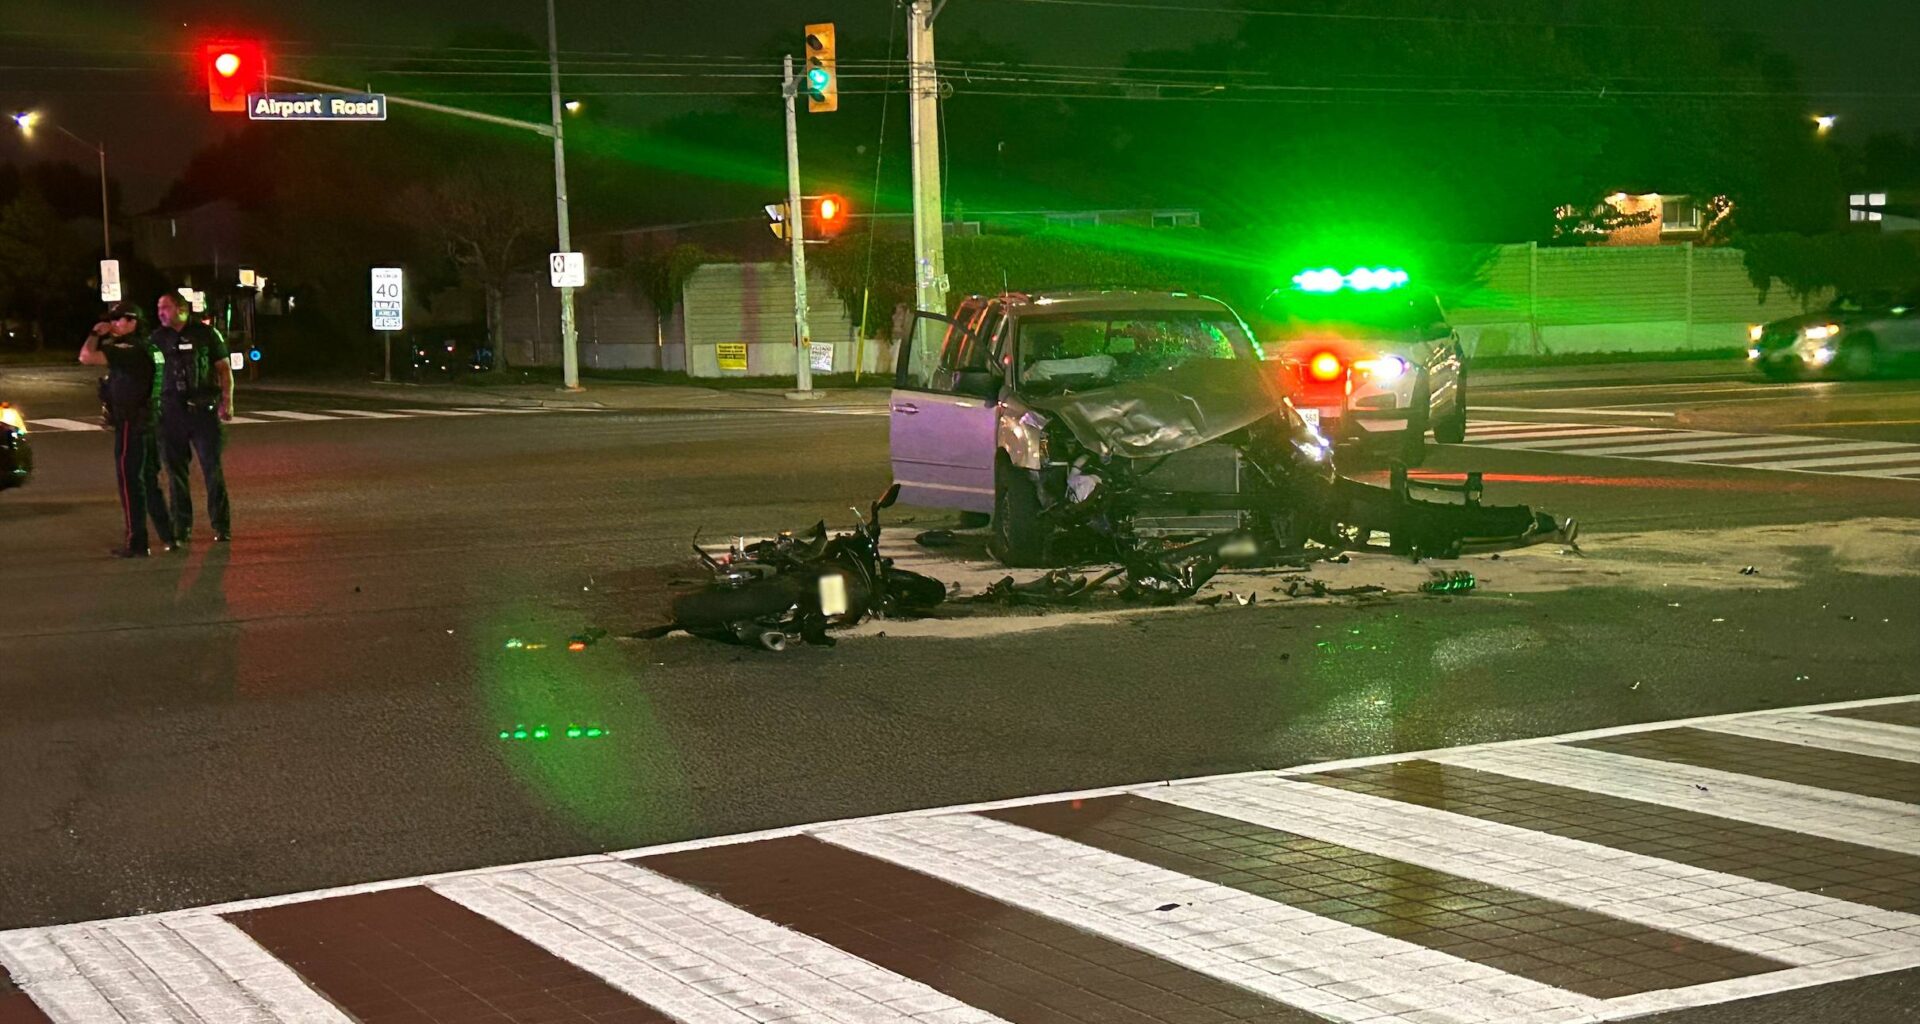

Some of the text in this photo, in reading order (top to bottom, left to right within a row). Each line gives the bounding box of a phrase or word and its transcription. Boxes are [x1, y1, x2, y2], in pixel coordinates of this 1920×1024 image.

[255, 98, 379, 118] Airport Road
[376, 283, 399, 298] 40
